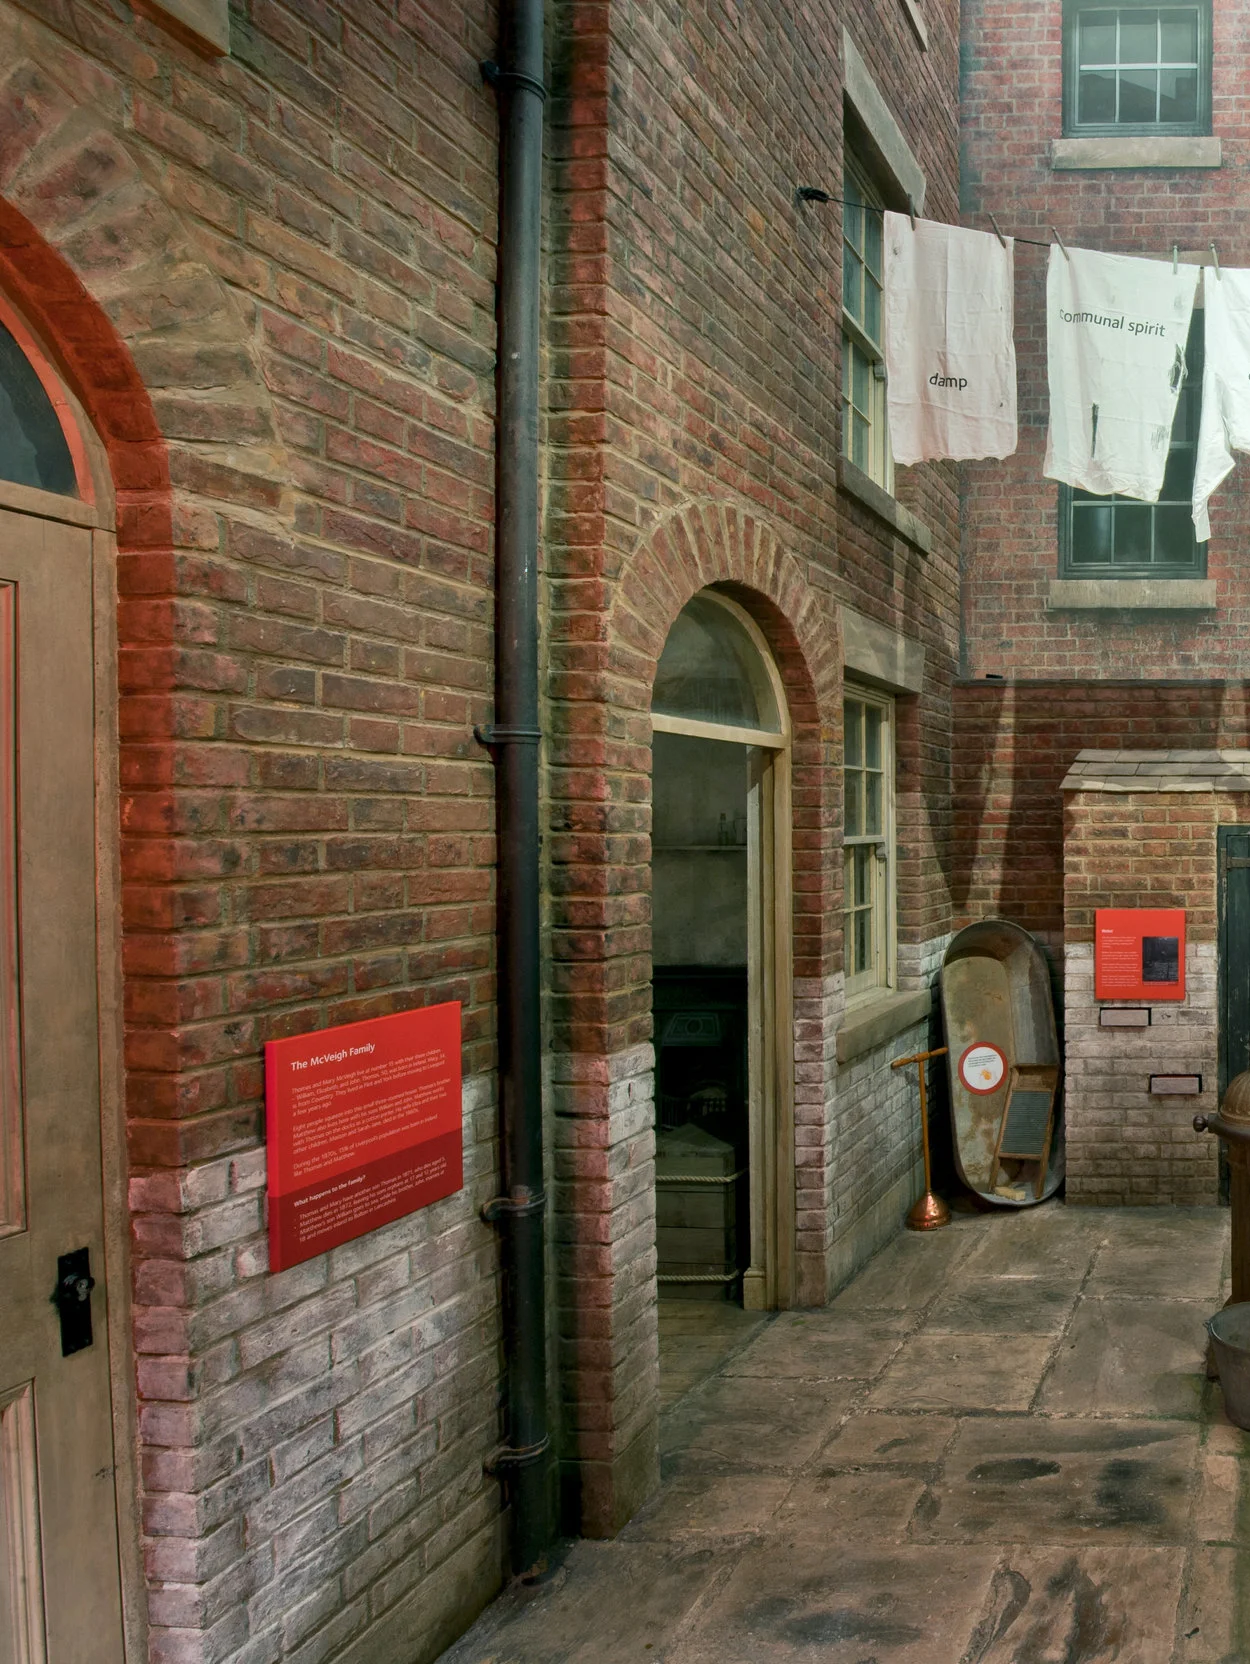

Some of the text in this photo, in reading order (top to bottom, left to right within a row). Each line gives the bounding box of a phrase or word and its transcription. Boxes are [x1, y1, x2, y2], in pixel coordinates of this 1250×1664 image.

[1060, 308, 1166, 337] communal spirit
[929, 372, 968, 391] damp
[292, 1043, 375, 1071] The McVeigh Family
